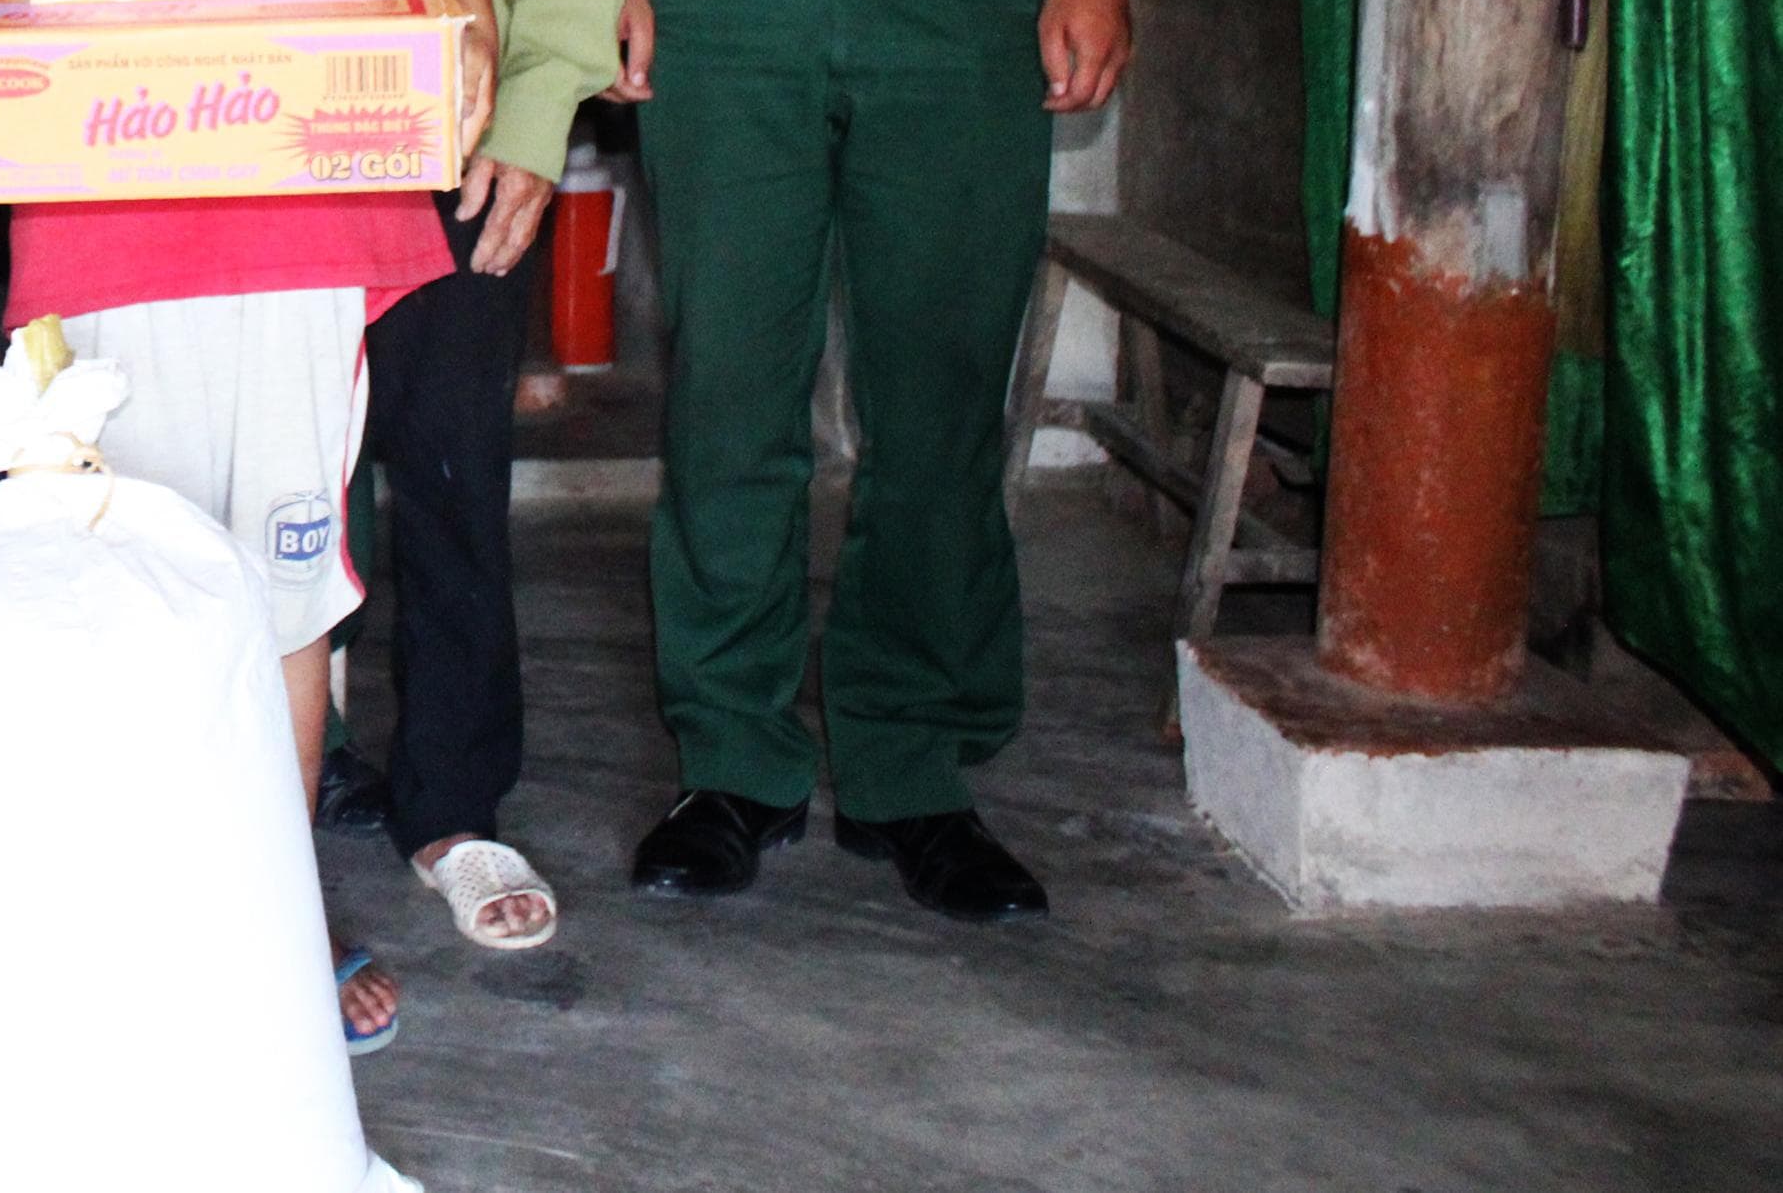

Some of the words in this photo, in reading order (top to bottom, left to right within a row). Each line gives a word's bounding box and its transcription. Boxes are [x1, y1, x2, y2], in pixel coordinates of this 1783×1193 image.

[83, 84, 178, 147] Hảo
[185, 70, 280, 133] Hảo
[309, 151, 353, 182] 02
[360, 144, 422, 181] GÓI
[279, 524, 330, 554] BOY
